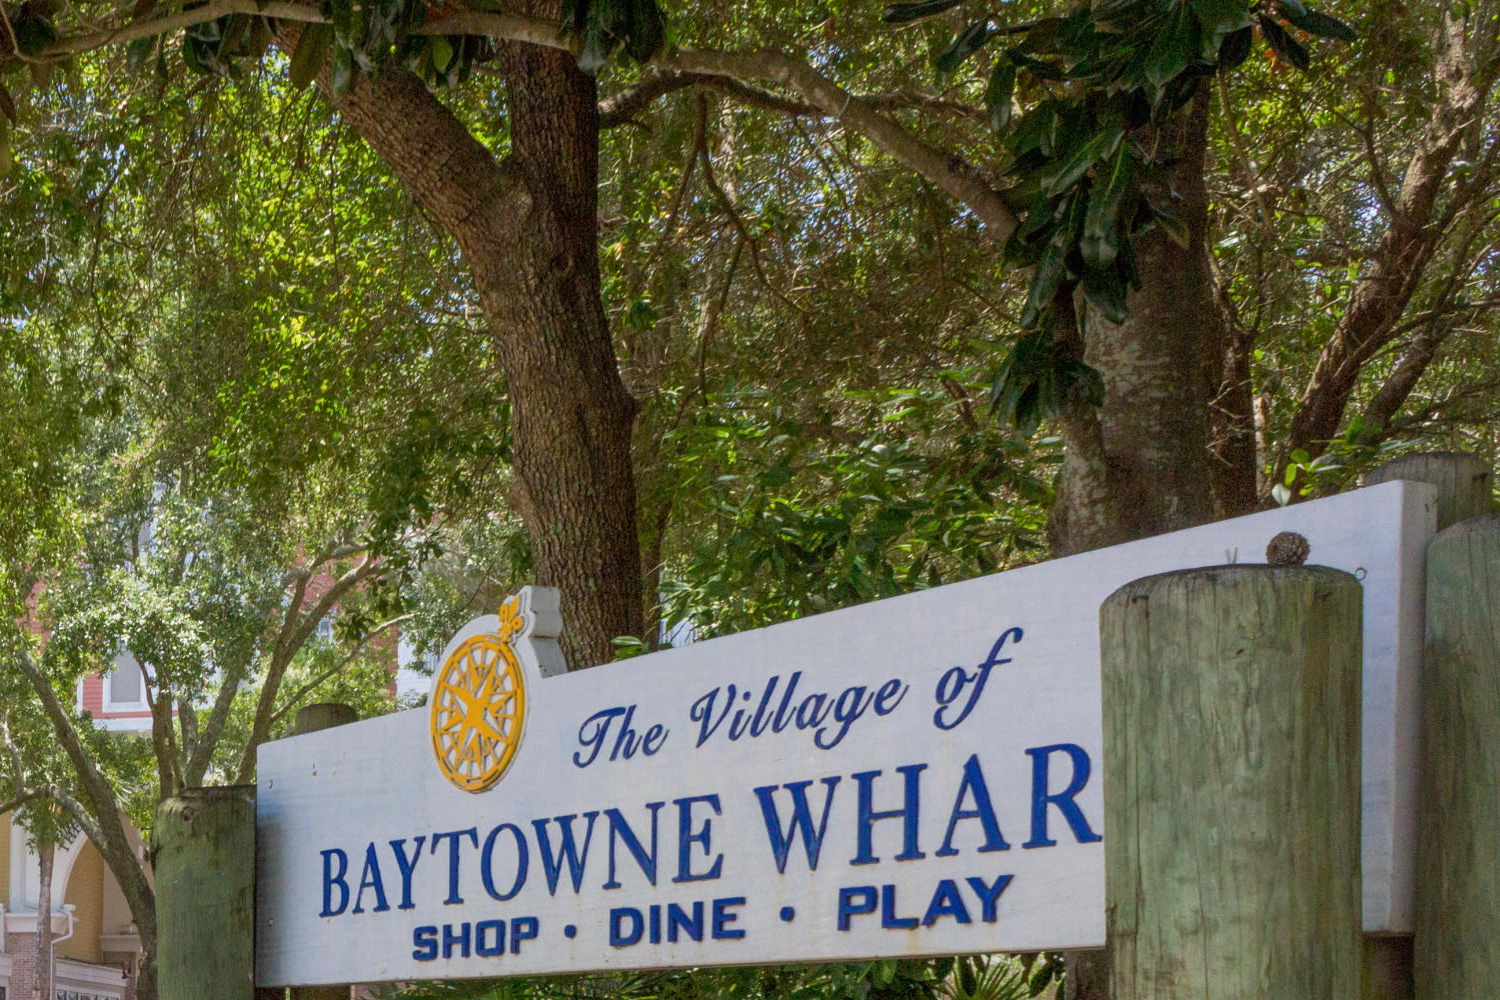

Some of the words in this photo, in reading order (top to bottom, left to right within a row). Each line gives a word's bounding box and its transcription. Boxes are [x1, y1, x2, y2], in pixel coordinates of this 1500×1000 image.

[572, 704, 669, 768] The
[690, 671, 910, 751] Village
[932, 626, 1024, 731] of
[318, 793, 724, 918] BAYTOWNE
[753, 742, 1103, 875] WHAR
[411, 916, 539, 962] SHOP
[608, 896, 747, 948] DINE
[836, 874, 1015, 932] PLAY
